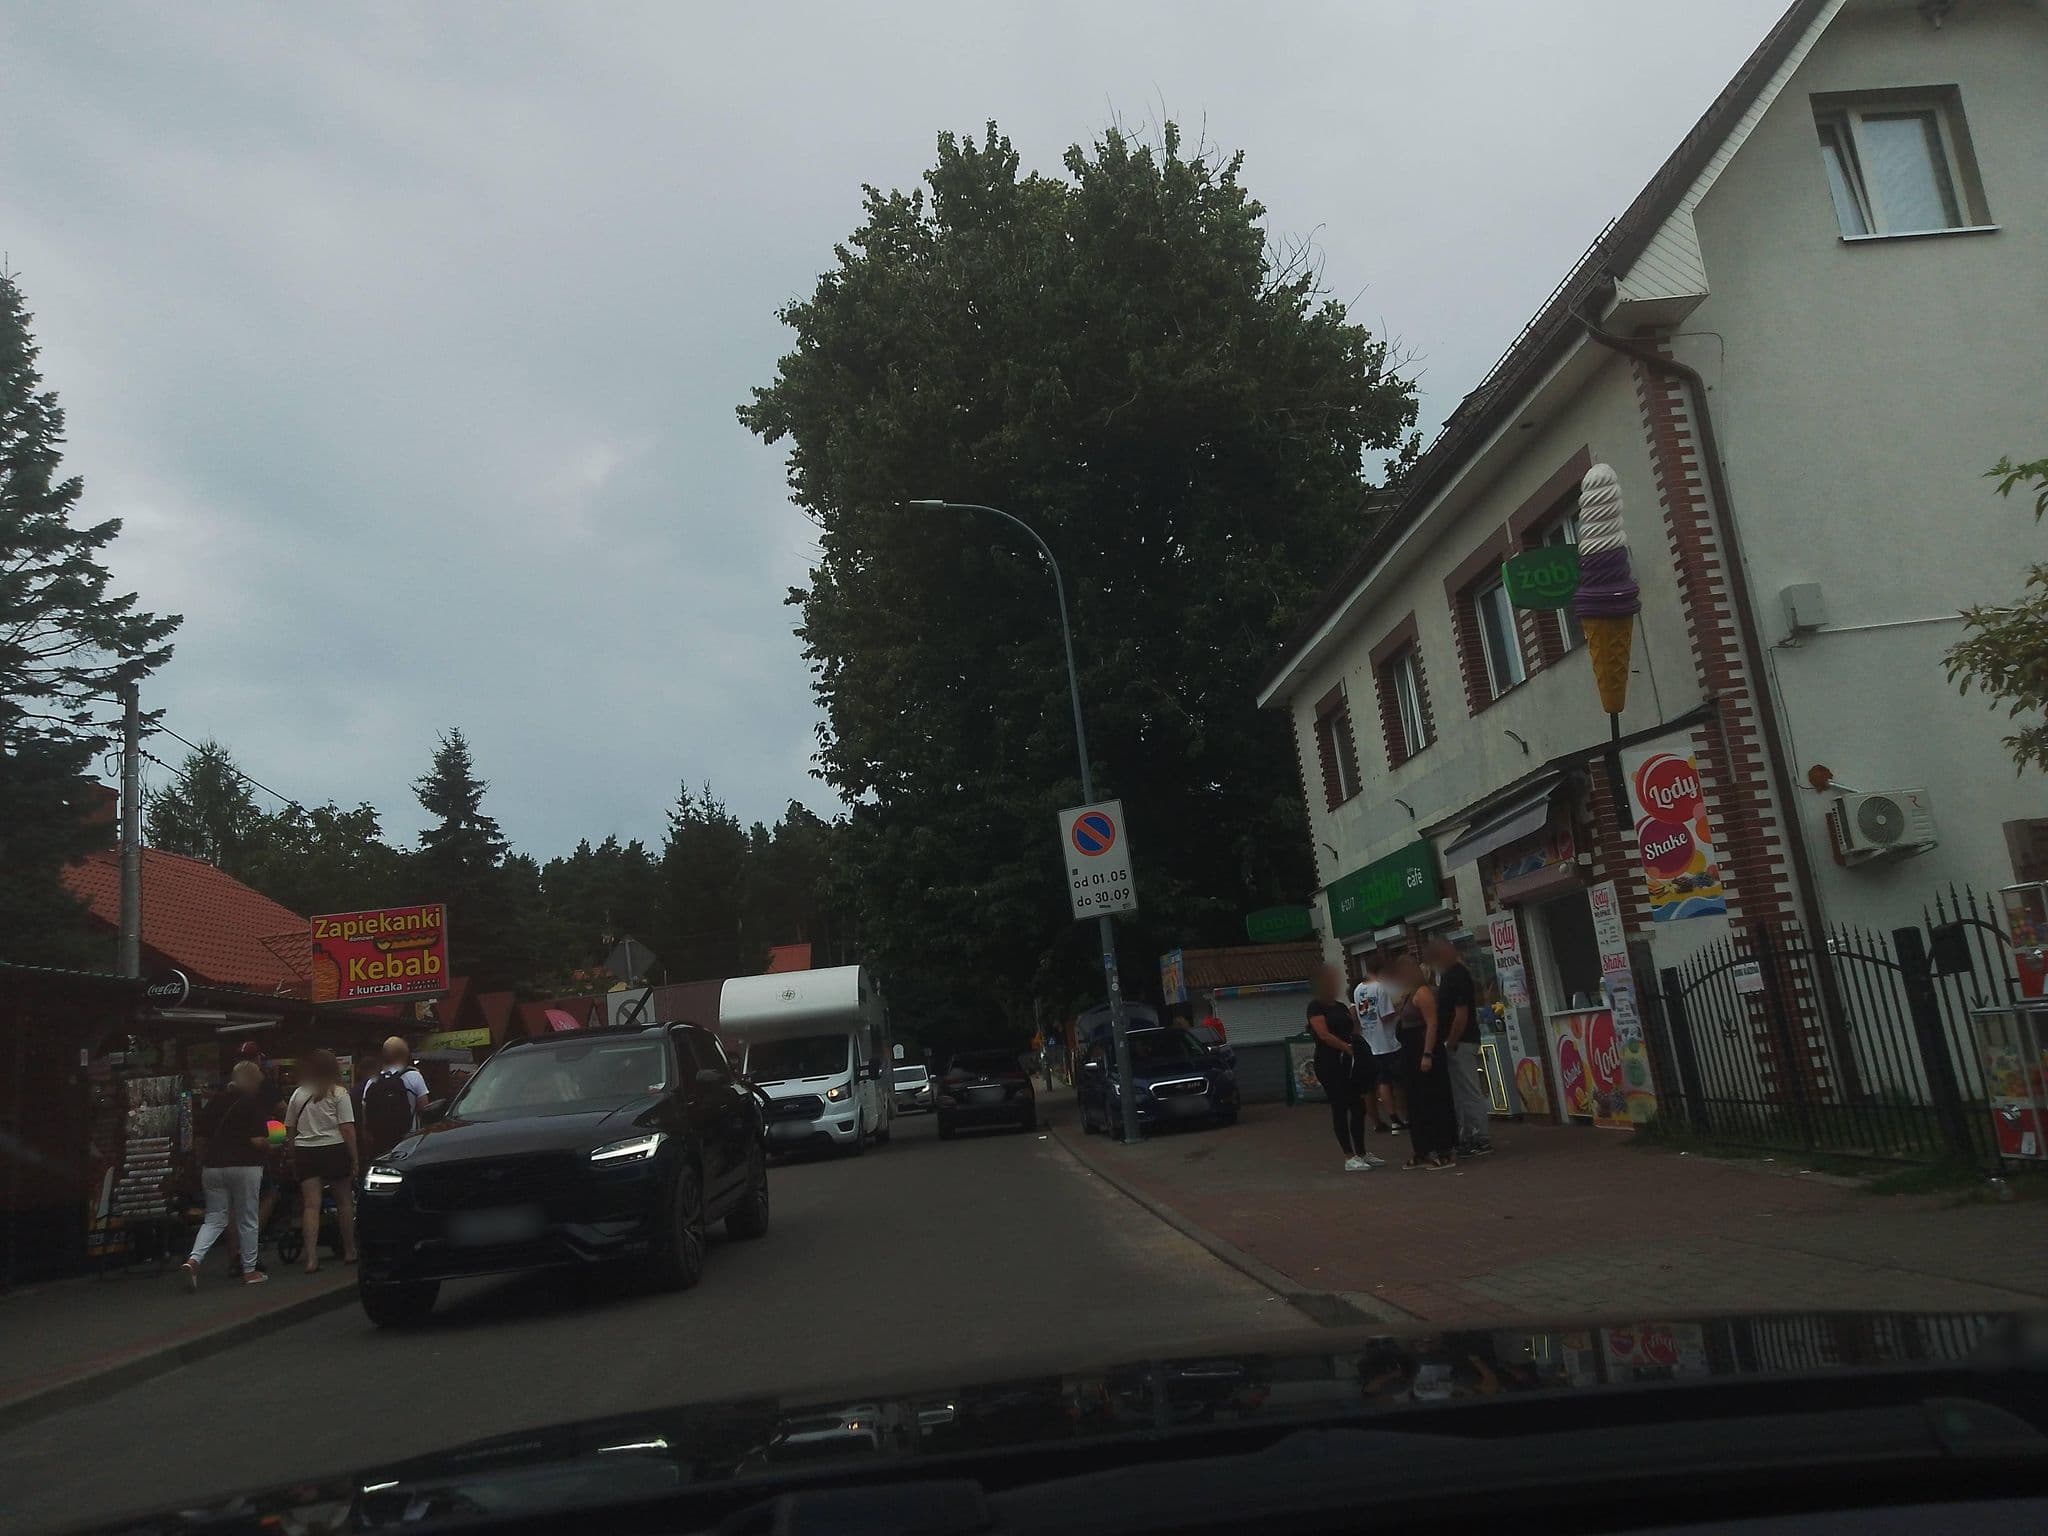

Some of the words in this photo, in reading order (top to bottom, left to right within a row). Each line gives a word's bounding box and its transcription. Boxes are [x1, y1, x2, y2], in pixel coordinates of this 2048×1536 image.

[1649, 776, 1698, 809] Lody
[1644, 832, 1688, 860] Shake
[1074, 876, 1089, 888] od
[1092, 869, 1127, 885] 01.05
[1077, 895, 1091, 907] do
[1095, 888, 1130, 903] 30.09
[314, 908, 441, 940] Zapiekanki
[1491, 921, 1516, 953] Lody
[349, 949, 441, 981] Kebab
[1602, 953, 1627, 972] Shake
[357, 981, 403, 995] kurczaka
